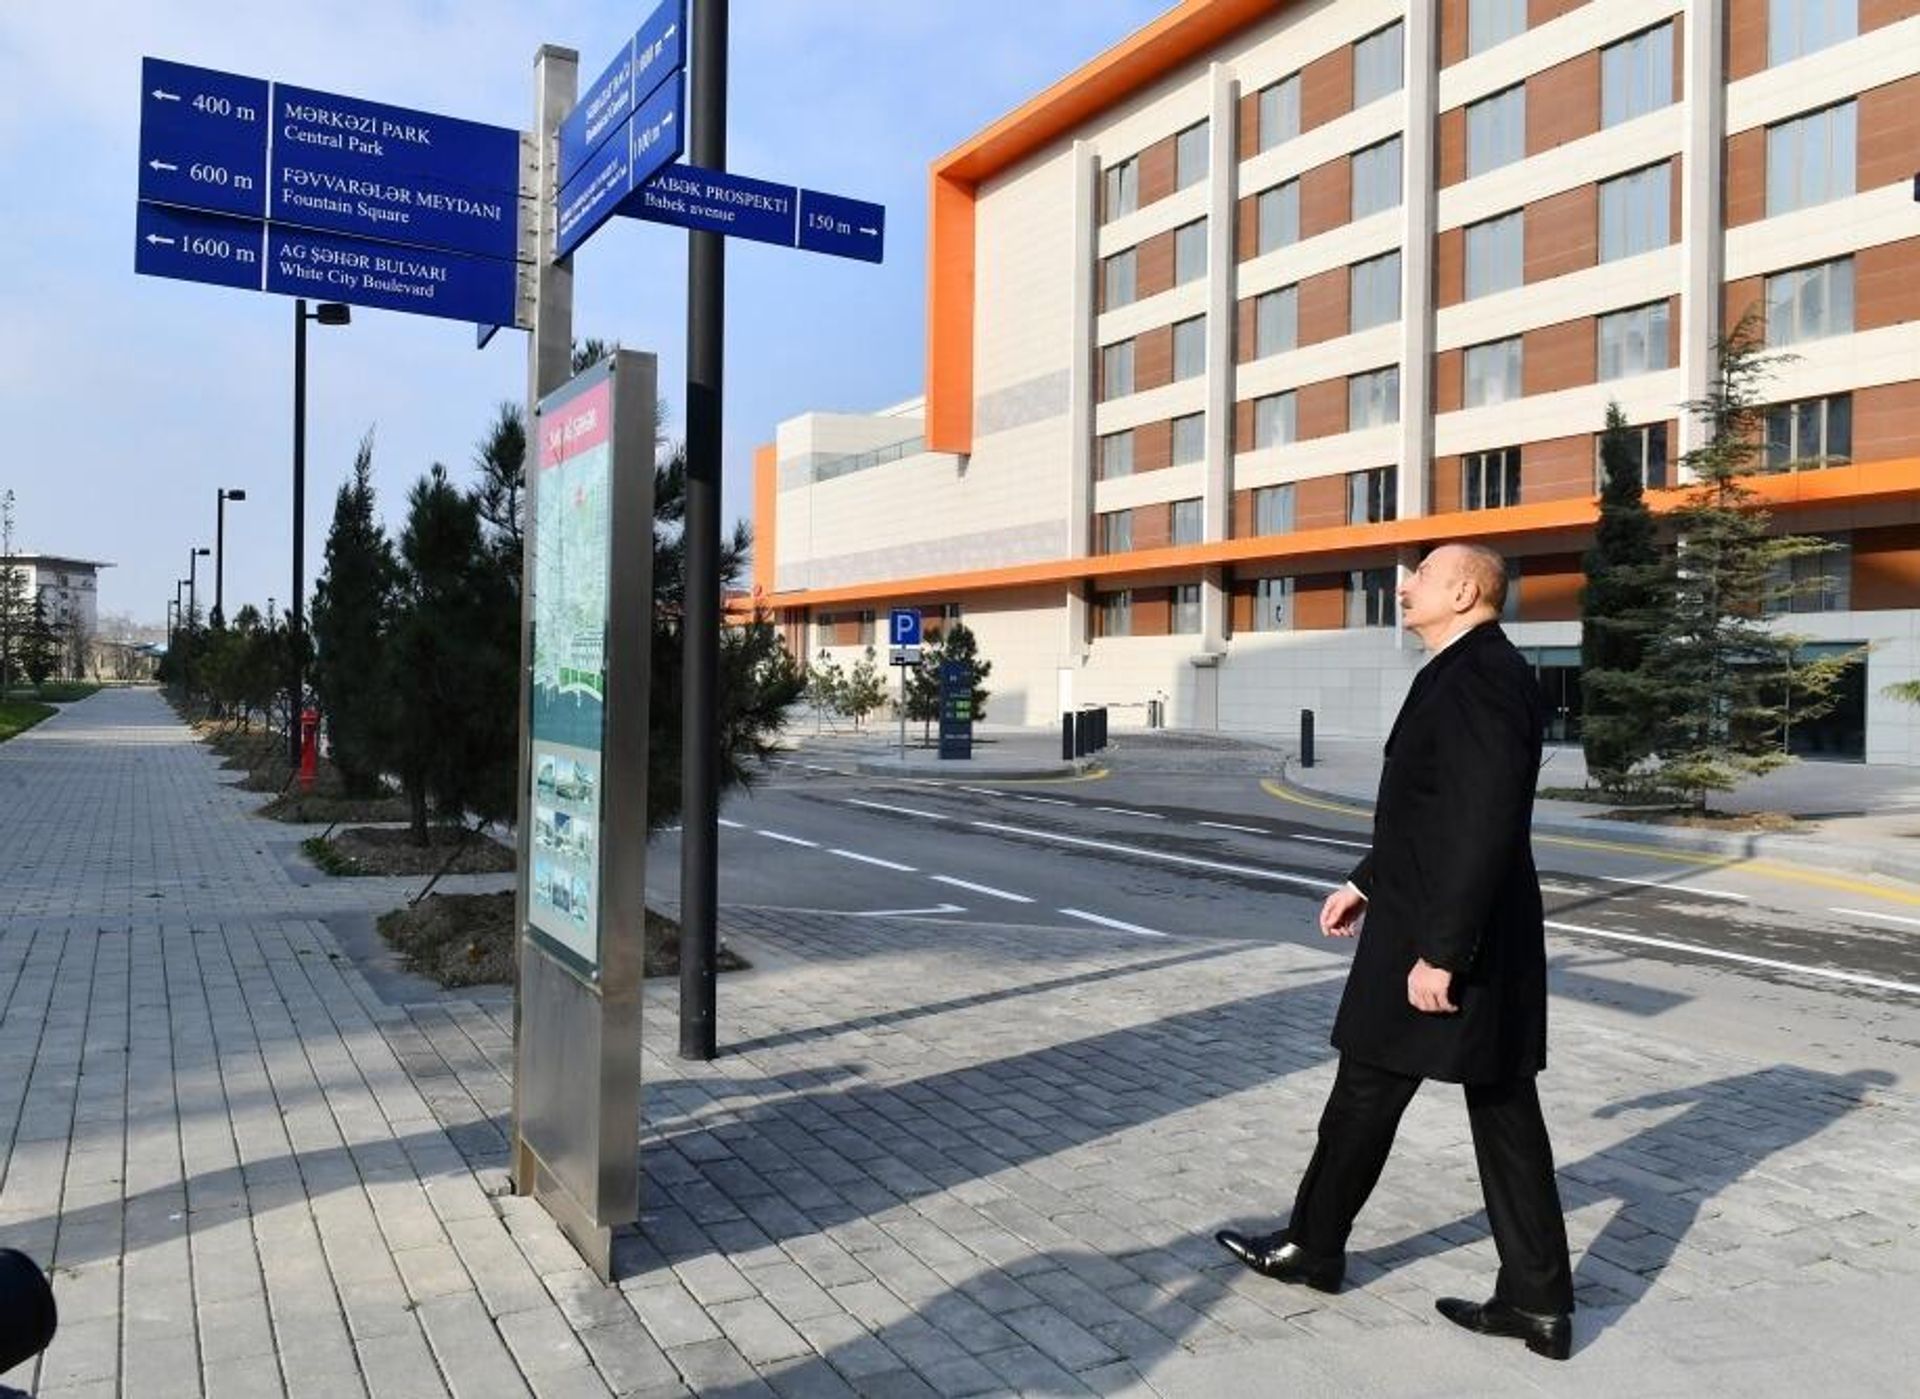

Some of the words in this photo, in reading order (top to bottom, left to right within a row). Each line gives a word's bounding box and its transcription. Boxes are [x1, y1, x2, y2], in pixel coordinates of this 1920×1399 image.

[192, 94, 231, 117] 400
[236, 106, 255, 121] m
[284, 102, 378, 134] MƏRKƏZİ
[382, 121, 432, 145] PARK
[284, 125, 343, 149] Central
[348, 137, 384, 156] Park
[190, 163, 228, 185] 600
[233, 174, 253, 190] m
[282, 188, 353, 214] Fountain
[357, 202, 410, 224] Square
[283, 167, 412, 204] FƏVVARƏLƏR
[415, 191, 502, 222] MEYDANI
[645, 192, 686, 212] Babek
[690, 204, 736, 222] avenue
[705, 185, 789, 214] PROSPEKTİ
[808, 212, 834, 230] 150
[837, 222, 851, 235] m
[183, 235, 230, 259] 1600
[236, 248, 255, 263] m
[311, 246, 371, 269] ŞƏHƏR
[375, 257, 448, 282] BULVARI
[280, 261, 324, 281] White
[327, 269, 359, 289] City
[363, 275, 434, 297] Boulevard
[896, 614, 914, 641] P
